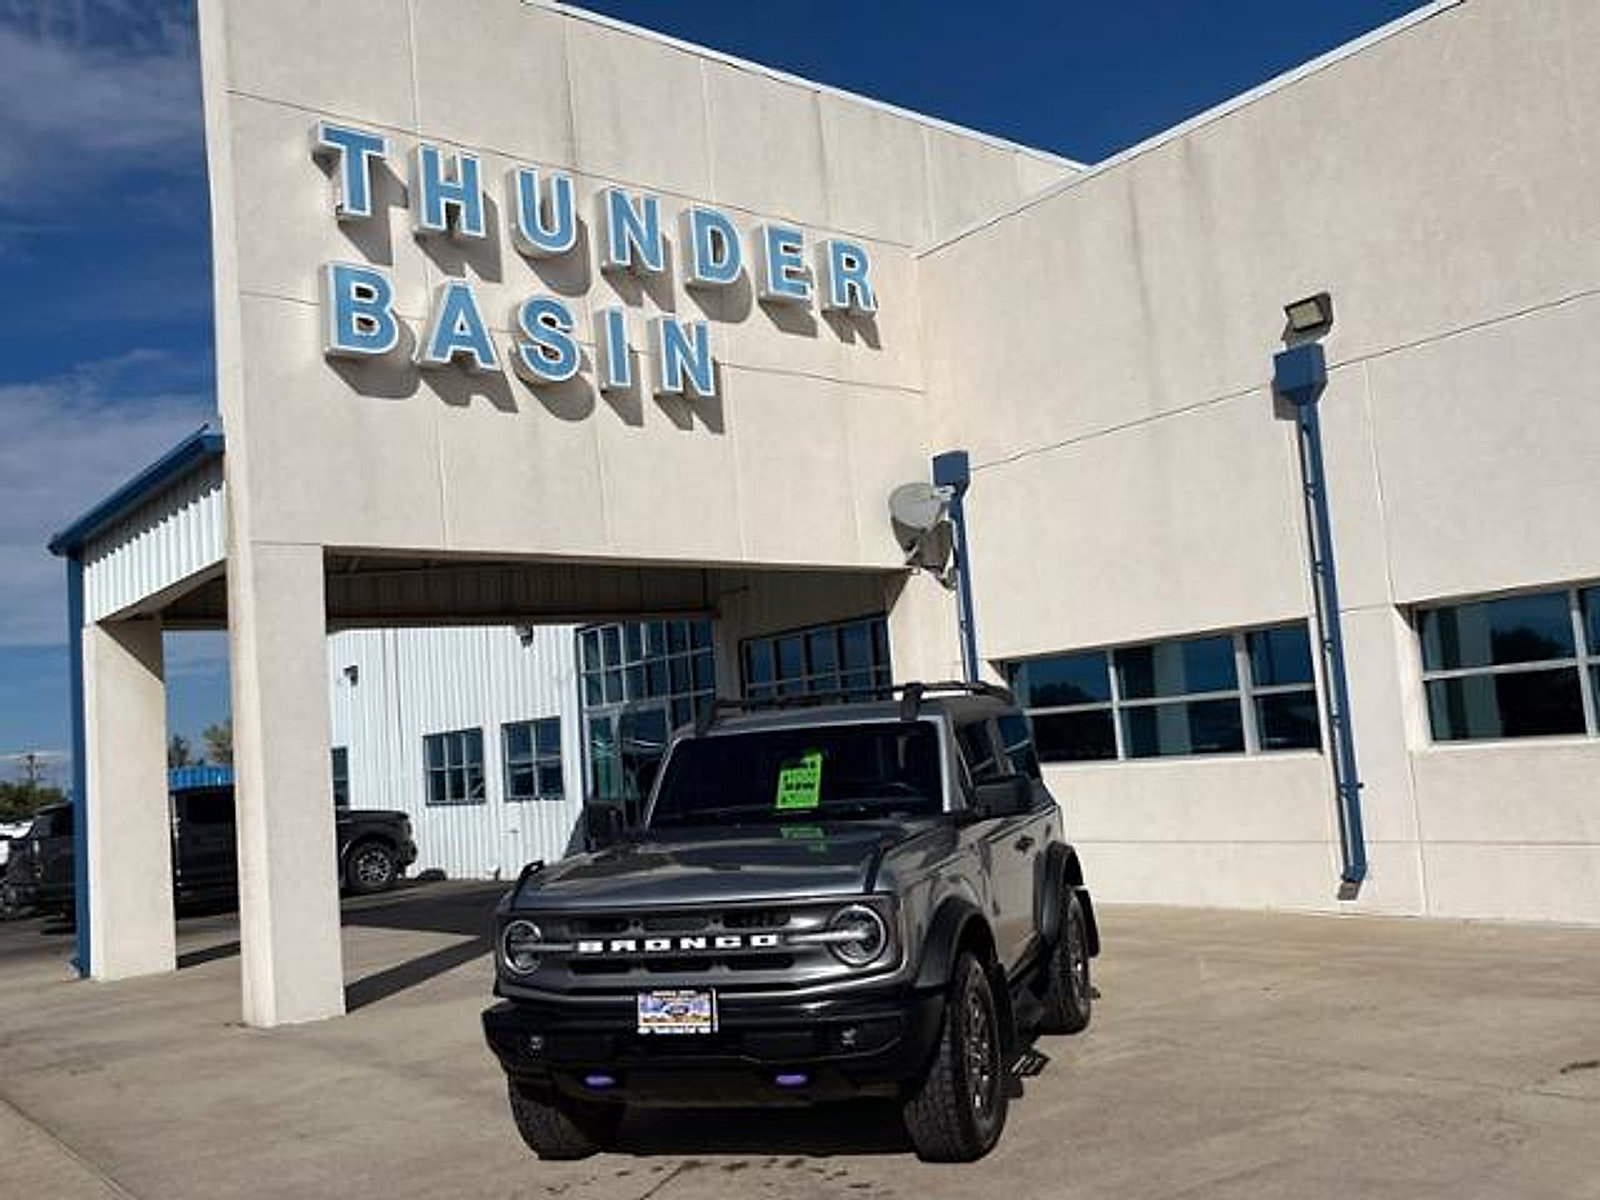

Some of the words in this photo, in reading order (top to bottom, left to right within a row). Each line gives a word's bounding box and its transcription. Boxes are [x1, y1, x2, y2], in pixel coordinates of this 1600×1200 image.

[314, 121, 876, 313] THUNDER
[324, 261, 716, 398] BASIN
[577, 933, 779, 955] BRONCO
